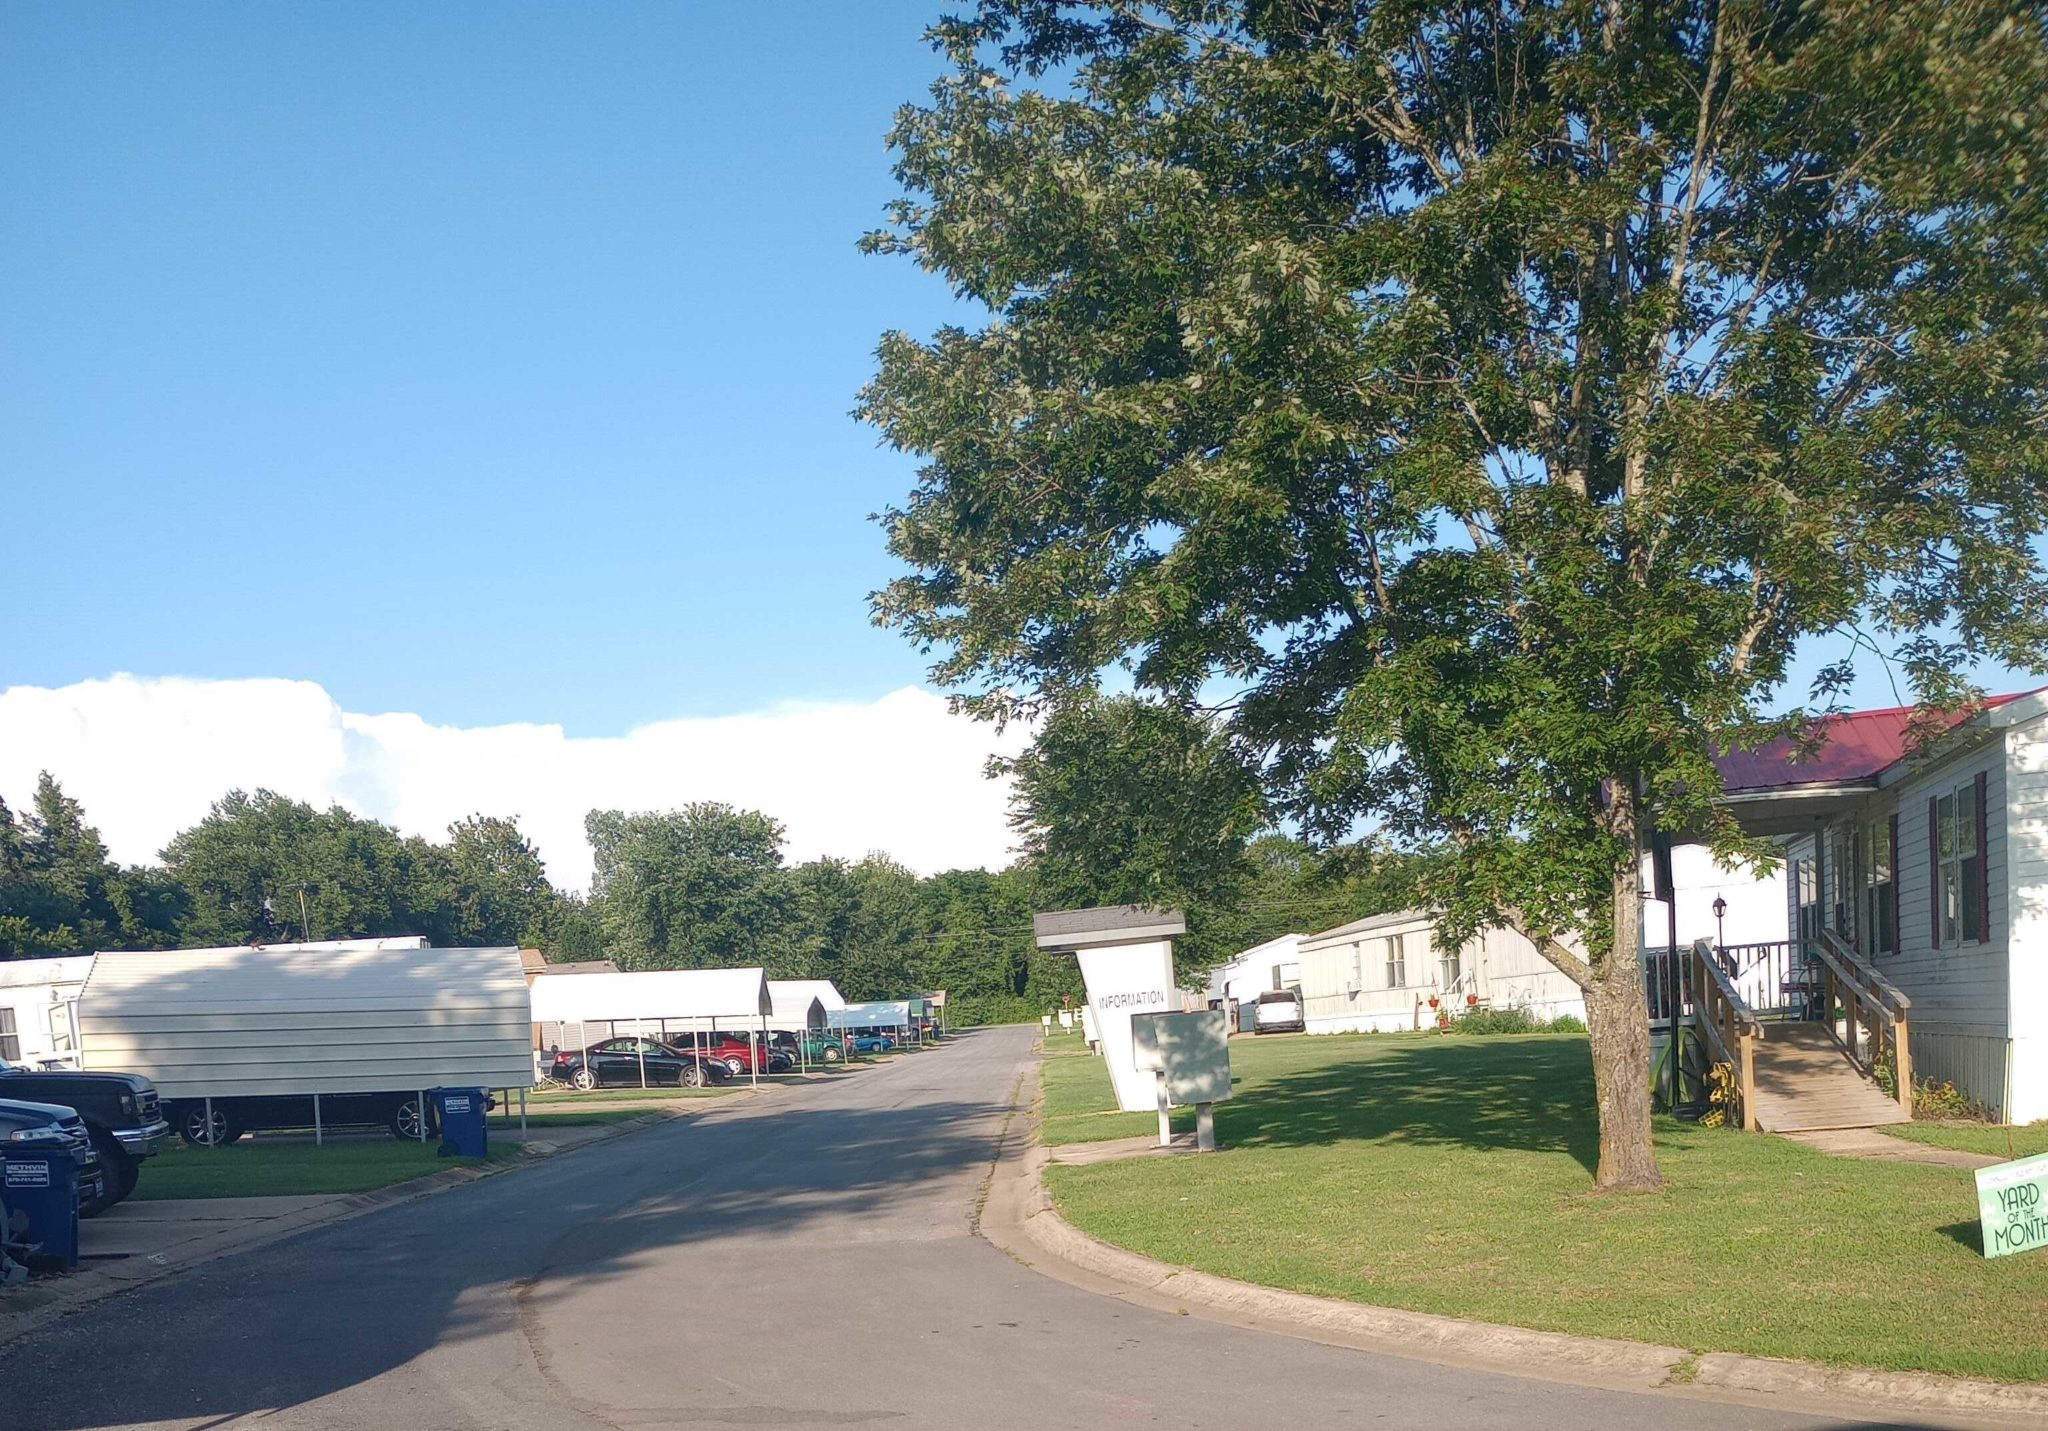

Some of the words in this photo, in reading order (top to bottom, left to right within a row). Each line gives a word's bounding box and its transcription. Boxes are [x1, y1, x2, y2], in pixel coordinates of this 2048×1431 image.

[1099, 990, 1164, 1009] INFORMATION
[1997, 1183, 2039, 1212] YARD
[2007, 1211, 2020, 1223] OF
[2023, 1207, 2036, 1220] THE
[1994, 1216, 2048, 1251] MONTH
